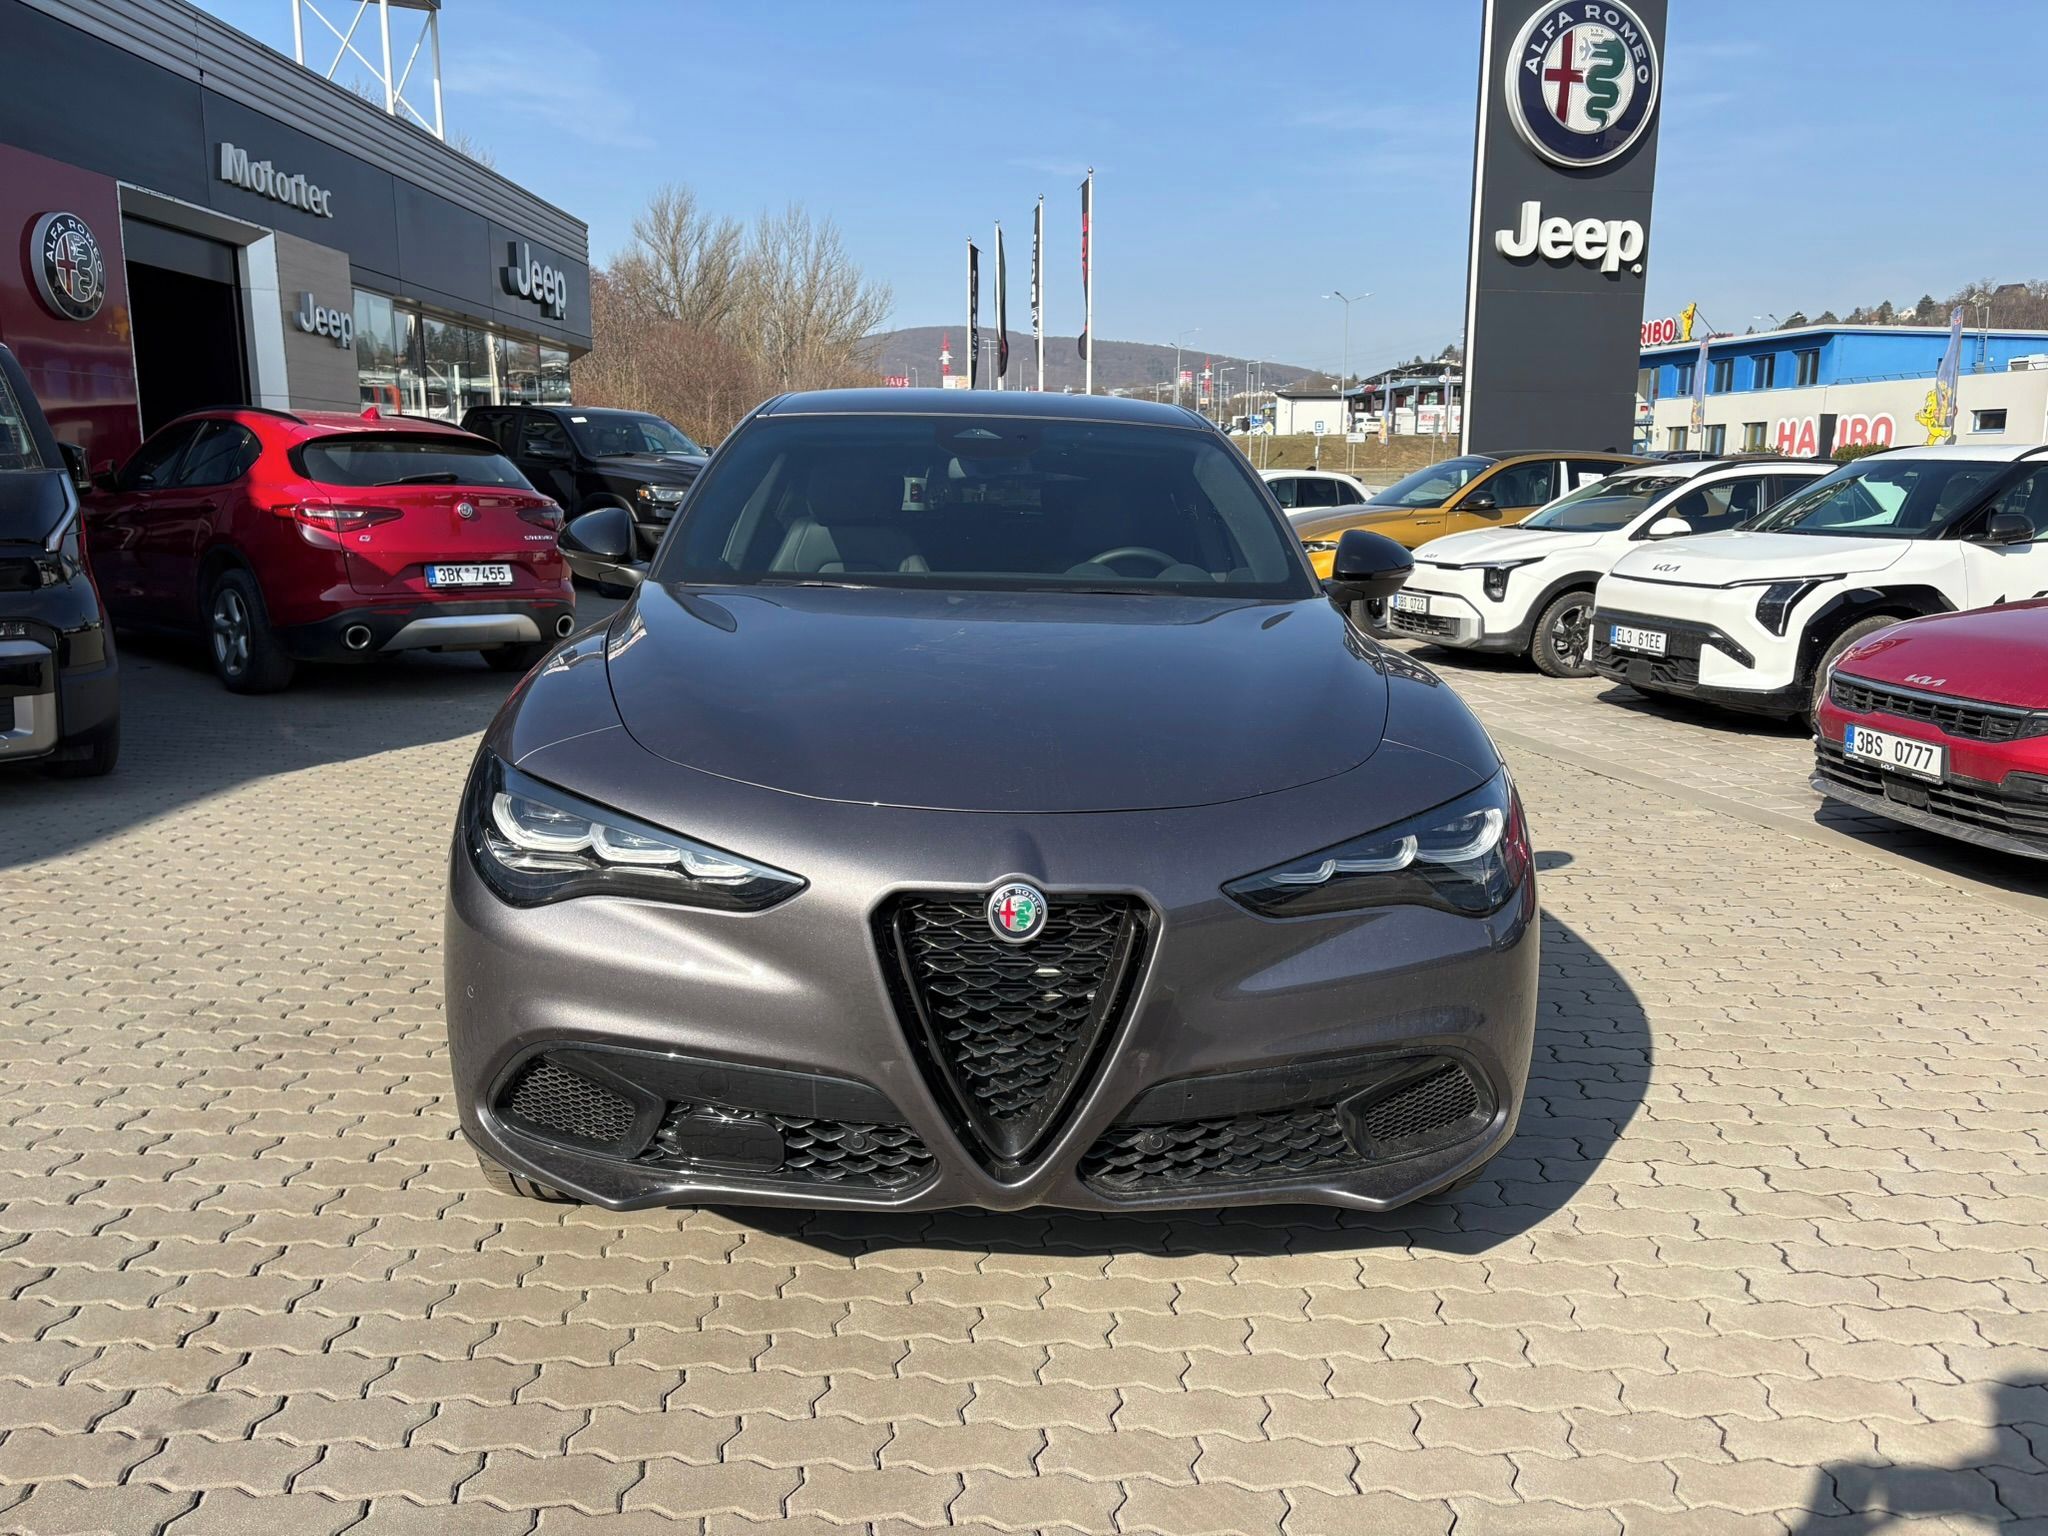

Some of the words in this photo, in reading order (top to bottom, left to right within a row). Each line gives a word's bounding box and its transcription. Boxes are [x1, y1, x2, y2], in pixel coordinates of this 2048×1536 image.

[1525, 11, 1574, 75] ALFA
[1585, 5, 1650, 84] ROMEO
[220, 142, 333, 219] Motortec
[46, 222, 65, 262] ALFA
[68, 219, 102, 272] ROMEO
[1495, 200, 1644, 273] Jeep
[512, 242, 566, 319] Jeep
[297, 291, 353, 349] Jeep
[1776, 413, 1895, 457] HAIBO
[438, 567, 464, 582] 3BK
[472, 566, 506, 581] 7455
[1409, 597, 1425, 611] 0722
[1616, 628, 1633, 644] EL3
[1638, 631, 1662, 650] 61EE
[1856, 731, 1883, 757] 3BS
[1894, 740, 1934, 770] 0777
[993, 891, 1011, 914] ALFA
[1014, 888, 1042, 915] ROMEO
